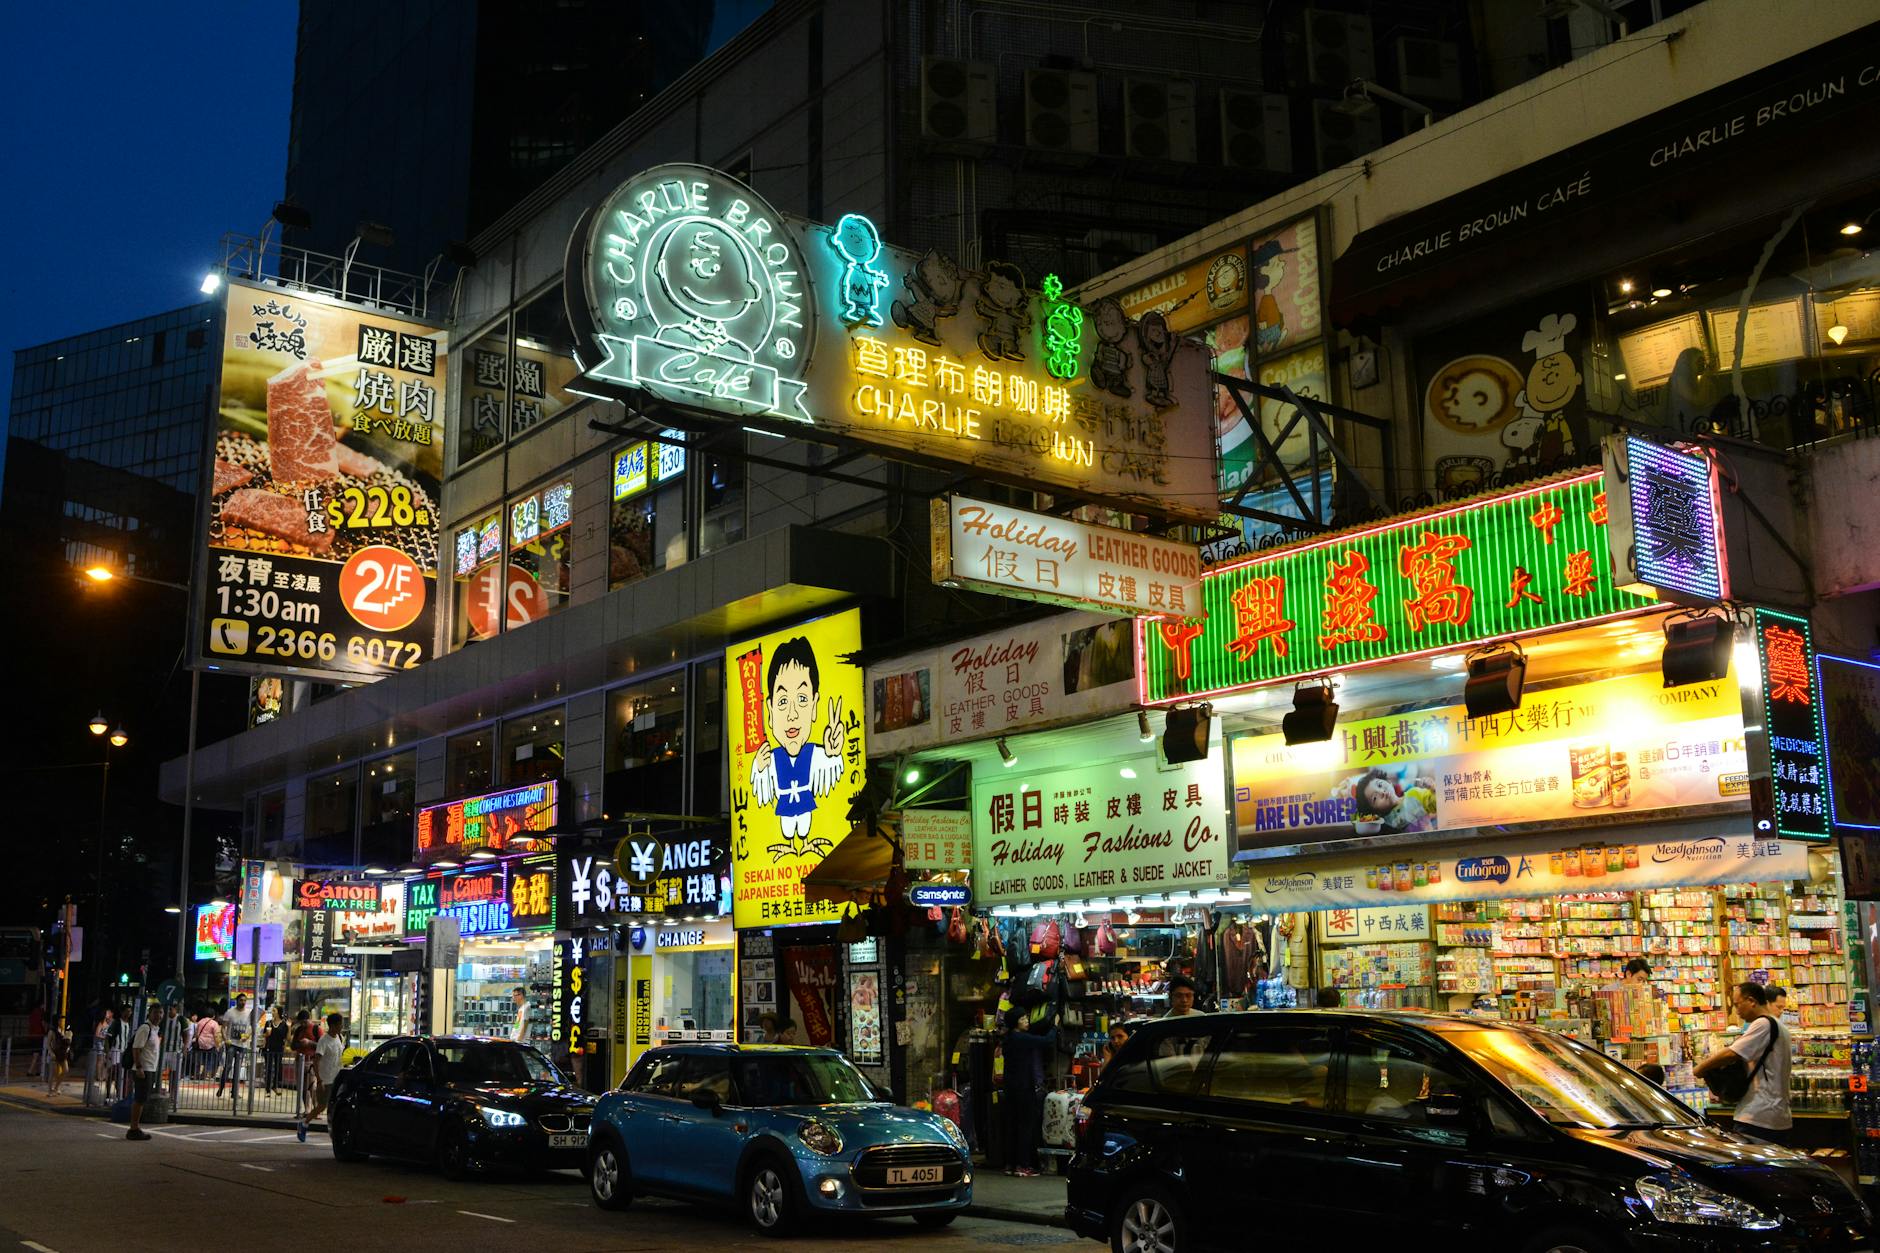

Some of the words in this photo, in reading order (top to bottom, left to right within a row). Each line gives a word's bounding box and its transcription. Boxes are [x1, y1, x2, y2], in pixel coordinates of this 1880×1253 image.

[1650, 116, 1745, 168] CHARLIE
[1756, 76, 1844, 128] BROWN
[1377, 230, 1450, 273] CHARLIE
[1459, 201, 1527, 241] BROWN
[1536, 171, 1592, 211] CAFÉ
[607, 179, 710, 285] CHARLIE
[725, 198, 803, 329] BROWN
[1120, 272, 1188, 309] CHARLIE
[659, 352, 755, 397] Café
[856, 336, 1071, 424] 查理布朗咖啡
[1261, 354, 1324, 385] Coffee
[354, 368, 434, 421] 焼肉
[351, 412, 432, 446] 食べ放題
[856, 385, 981, 441] CHARLIE
[661, 447, 680, 475] 1:30
[958, 506, 1077, 562] Holiday
[980, 544, 1060, 589] 假日
[1087, 533, 1149, 570] LEATHER
[1152, 547, 1197, 580] GOODS
[1149, 581, 1186, 612] 皮具
[256, 626, 337, 662] 2366
[346, 637, 422, 669] 6072
[951, 638, 1040, 676] Holiday
[965, 662, 1021, 695] 假日
[944, 695, 996, 718] LEATHER
[1003, 681, 1049, 704] GOODS
[1772, 736, 1818, 755] MEDICINE
[989, 790, 1043, 835] 假日
[1053, 801, 1090, 825] 時裝
[1162, 783, 1203, 812] 皮具
[1255, 803, 1287, 832] ARE
[1287, 801, 1300, 827] U
[991, 838, 1065, 867] Holiday
[1083, 823, 1174, 864] Fashions
[1184, 815, 1220, 853] Co.
[454, 876, 494, 900] Canon
[743, 866, 775, 884] SEKAI
[777, 865, 794, 880] NO
[990, 879, 1027, 896] LEATHER
[1074, 870, 1115, 888] LEATHER
[1120, 869, 1128, 883] &
[1132, 864, 1165, 882] SUEDE
[1172, 859, 1213, 879] JACKET
[1456, 862, 1509, 881] Enfagrow
[300, 882, 377, 899] Canon
[324, 899, 347, 909] TAX
[350, 899, 377, 910] FREE
[412, 884, 435, 906] TAX
[738, 884, 798, 902] JAPANESE
[916, 890, 966, 901] Samsonite
[657, 930, 704, 947] CHANGE
[1363, 911, 1425, 934] 中西成藥
[165, 985, 176, 1000] 7
[552, 944, 563, 1042] SAMSUNG
[643, 979, 651, 1036] WESTERN
[636, 997, 644, 1036] UNION
[553, 1136, 568, 1147] SH
[892, 1169, 908, 1183] TL
[910, 1166, 939, 1183] 4051
